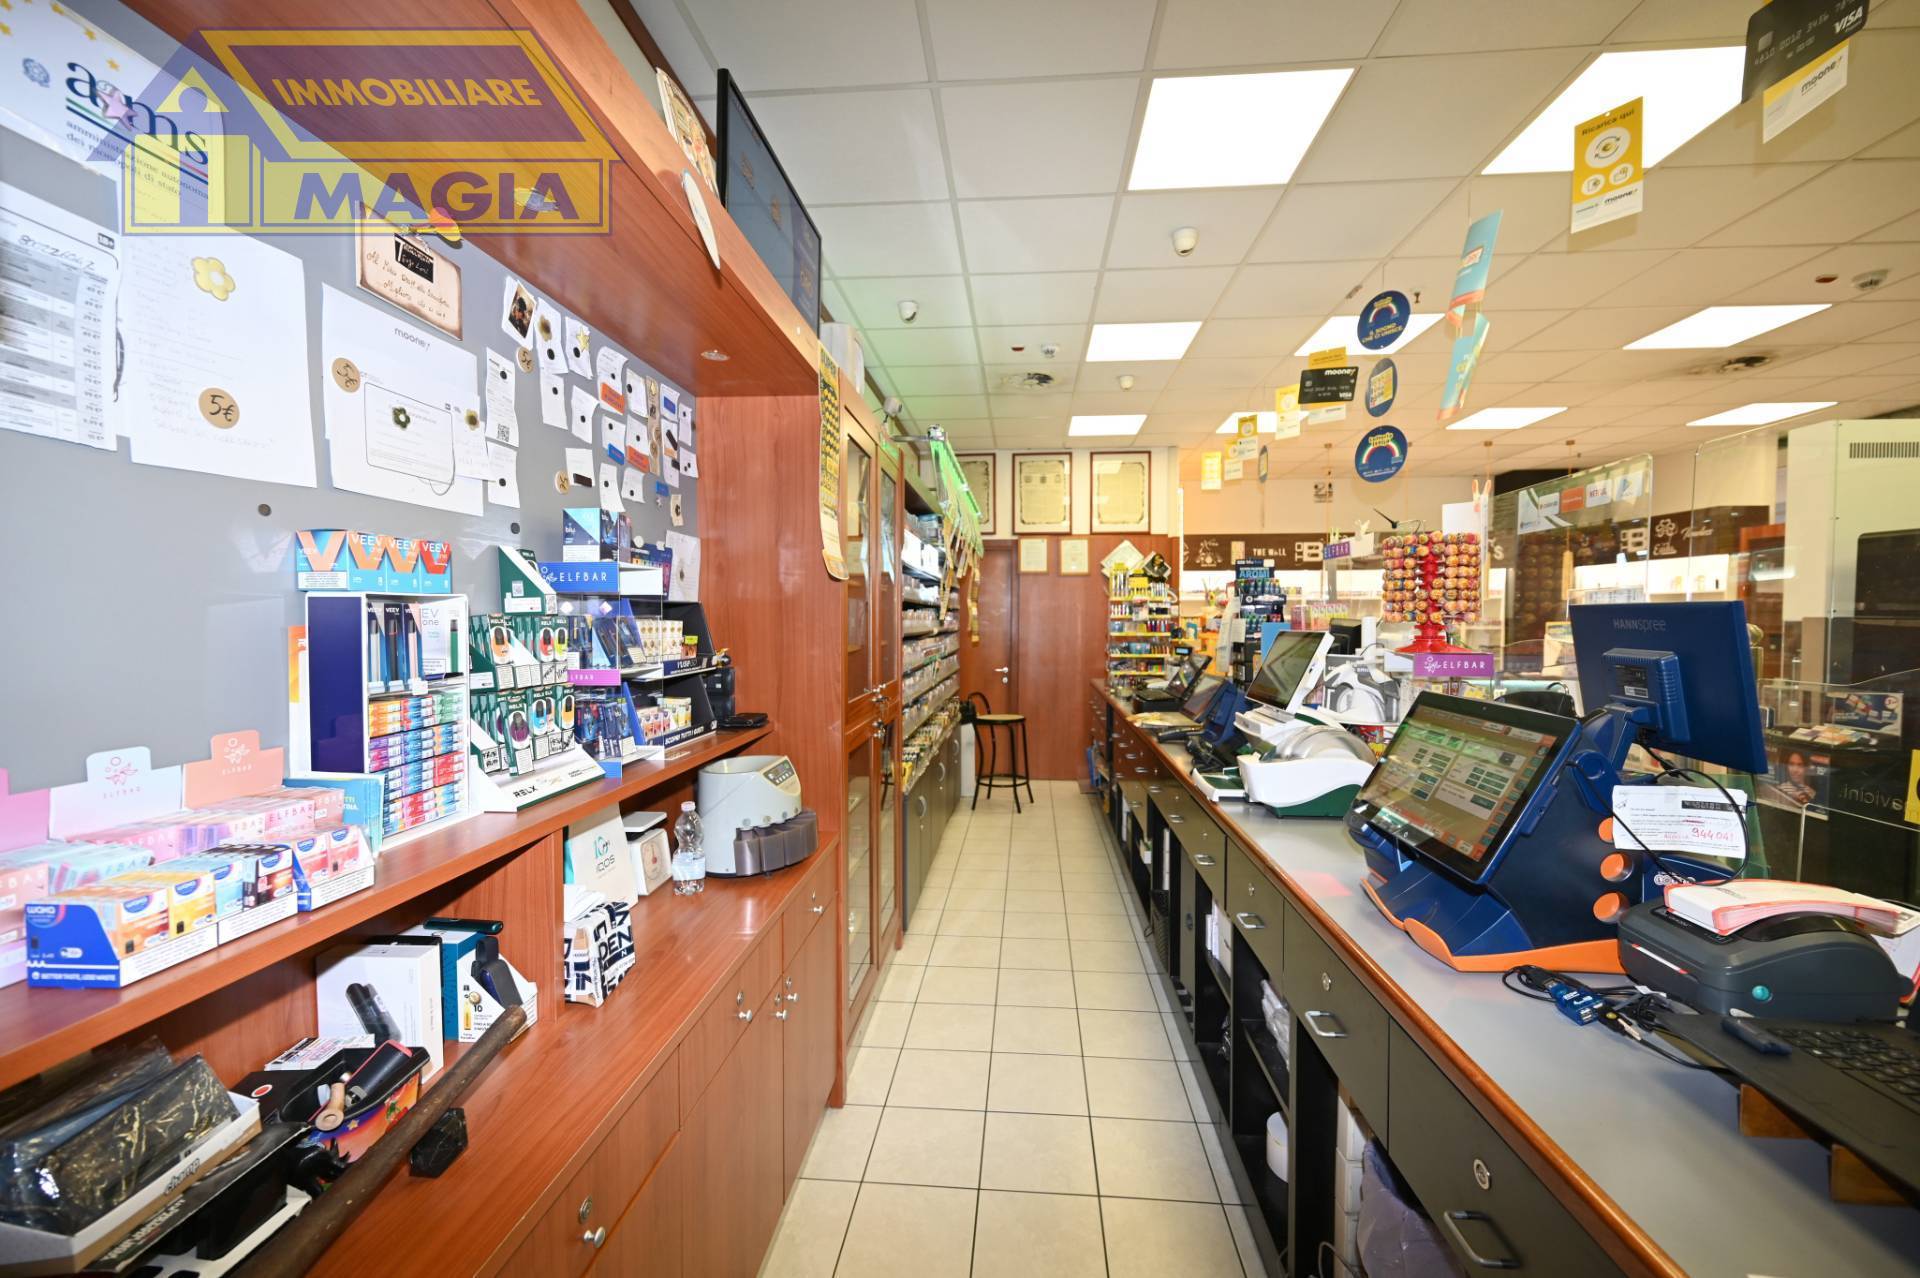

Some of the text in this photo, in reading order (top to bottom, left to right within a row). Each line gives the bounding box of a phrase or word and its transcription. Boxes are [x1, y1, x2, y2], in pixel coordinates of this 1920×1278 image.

[1834, 6, 1863, 34] VISA
[65, 62, 208, 166] ams
[1582, 117, 1617, 136] Ricarica
[1324, 368, 1356, 376] mooney
[209, 394, 235, 423] 5€
[351, 534, 383, 547] VEEV
[389, 539, 417, 550] VEEV
[422, 542, 448, 553] VEEV
[559, 571, 607, 582] ELFBAR
[1240, 571, 1270, 579] AROMI
[421, 608, 439, 619] EV
[1443, 660, 1486, 669] ELFBAR
[513, 785, 538, 799] RELX
[269, 804, 313, 822] ELFBAR
[164, 1158, 201, 1195] champ
